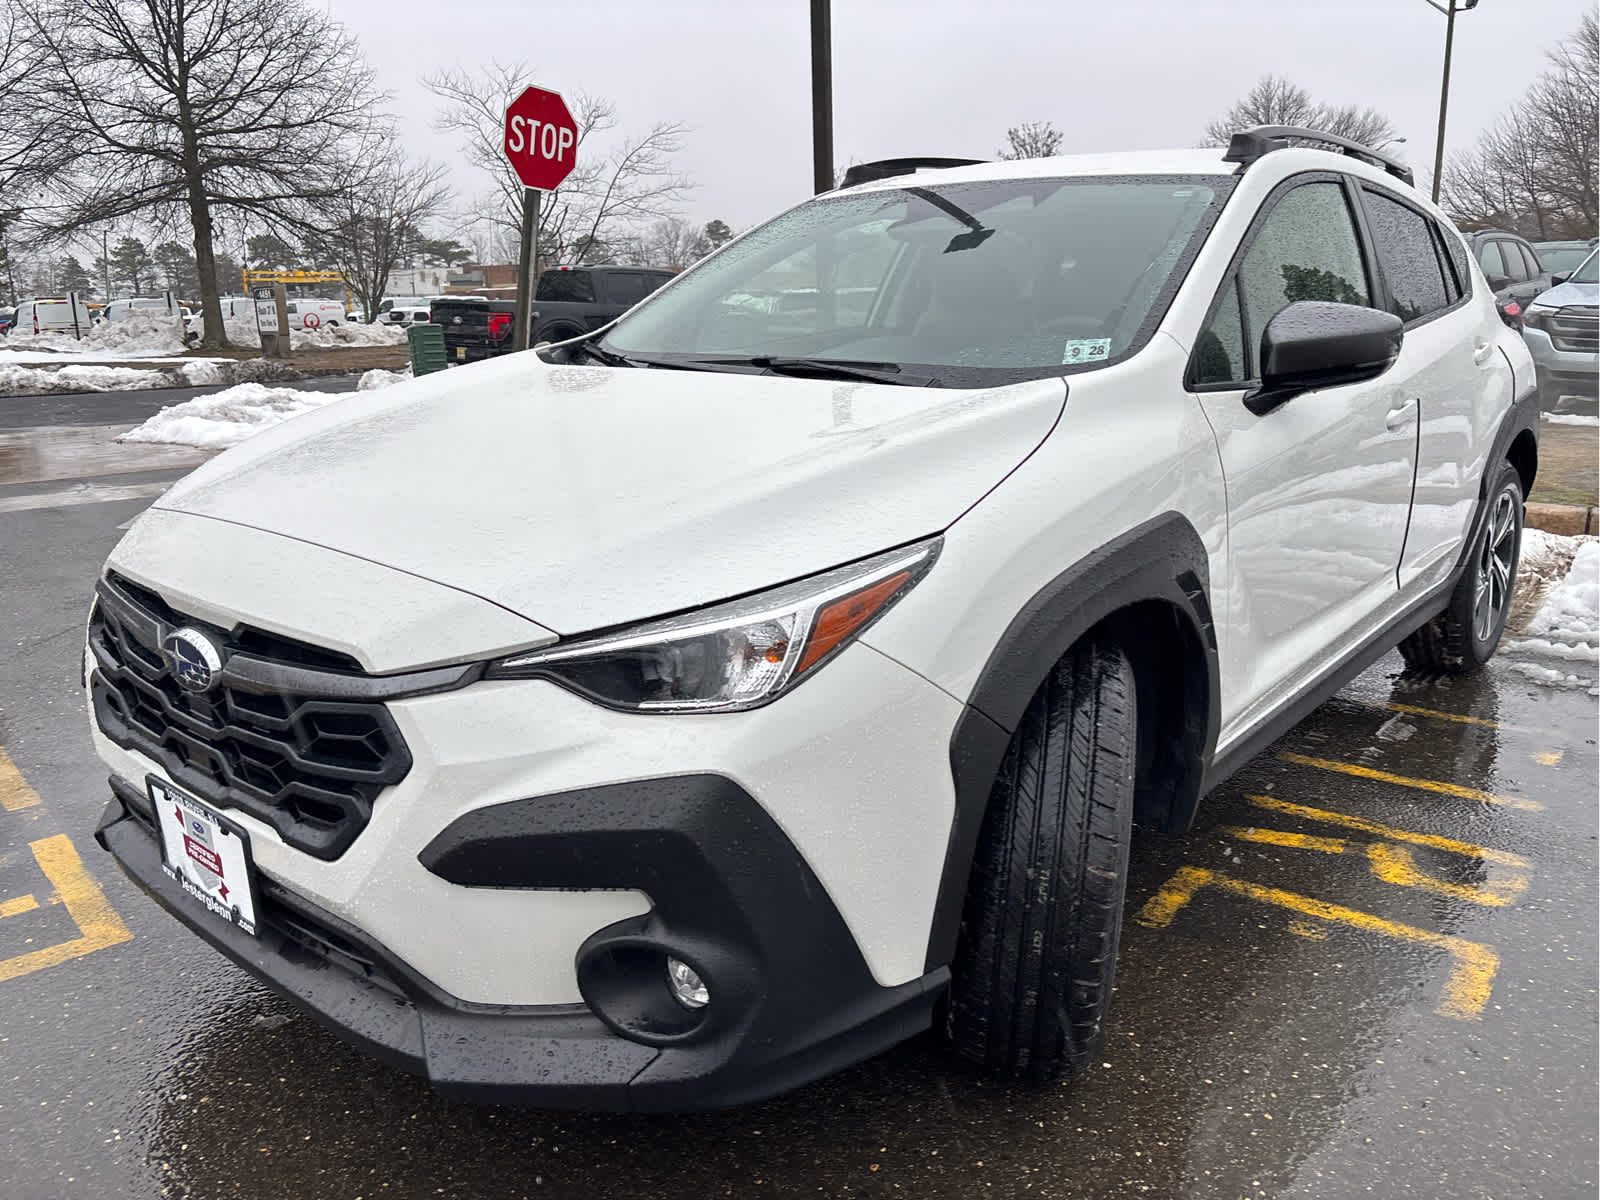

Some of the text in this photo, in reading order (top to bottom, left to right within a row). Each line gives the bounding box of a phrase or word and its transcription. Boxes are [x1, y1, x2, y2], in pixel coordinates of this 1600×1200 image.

[508, 114, 574, 162] STOP
[1071, 345, 1105, 357] 9 28
